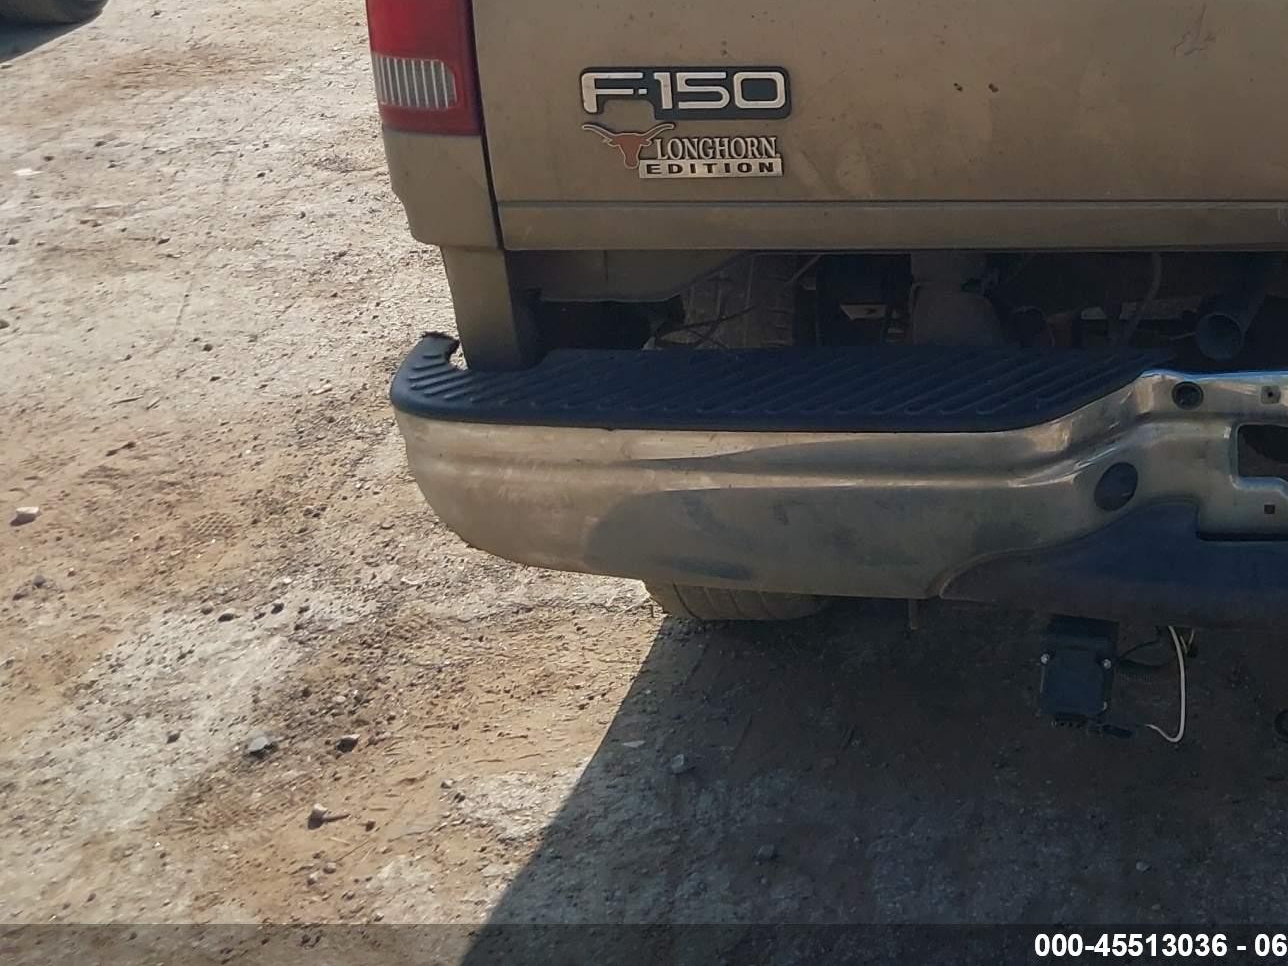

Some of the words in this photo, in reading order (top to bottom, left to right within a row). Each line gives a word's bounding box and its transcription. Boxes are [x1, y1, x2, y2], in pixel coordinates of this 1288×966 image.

[580, 71, 787, 114] F-150
[655, 137, 777, 160] LONGHORN
[646, 162, 774, 175] EDITION
